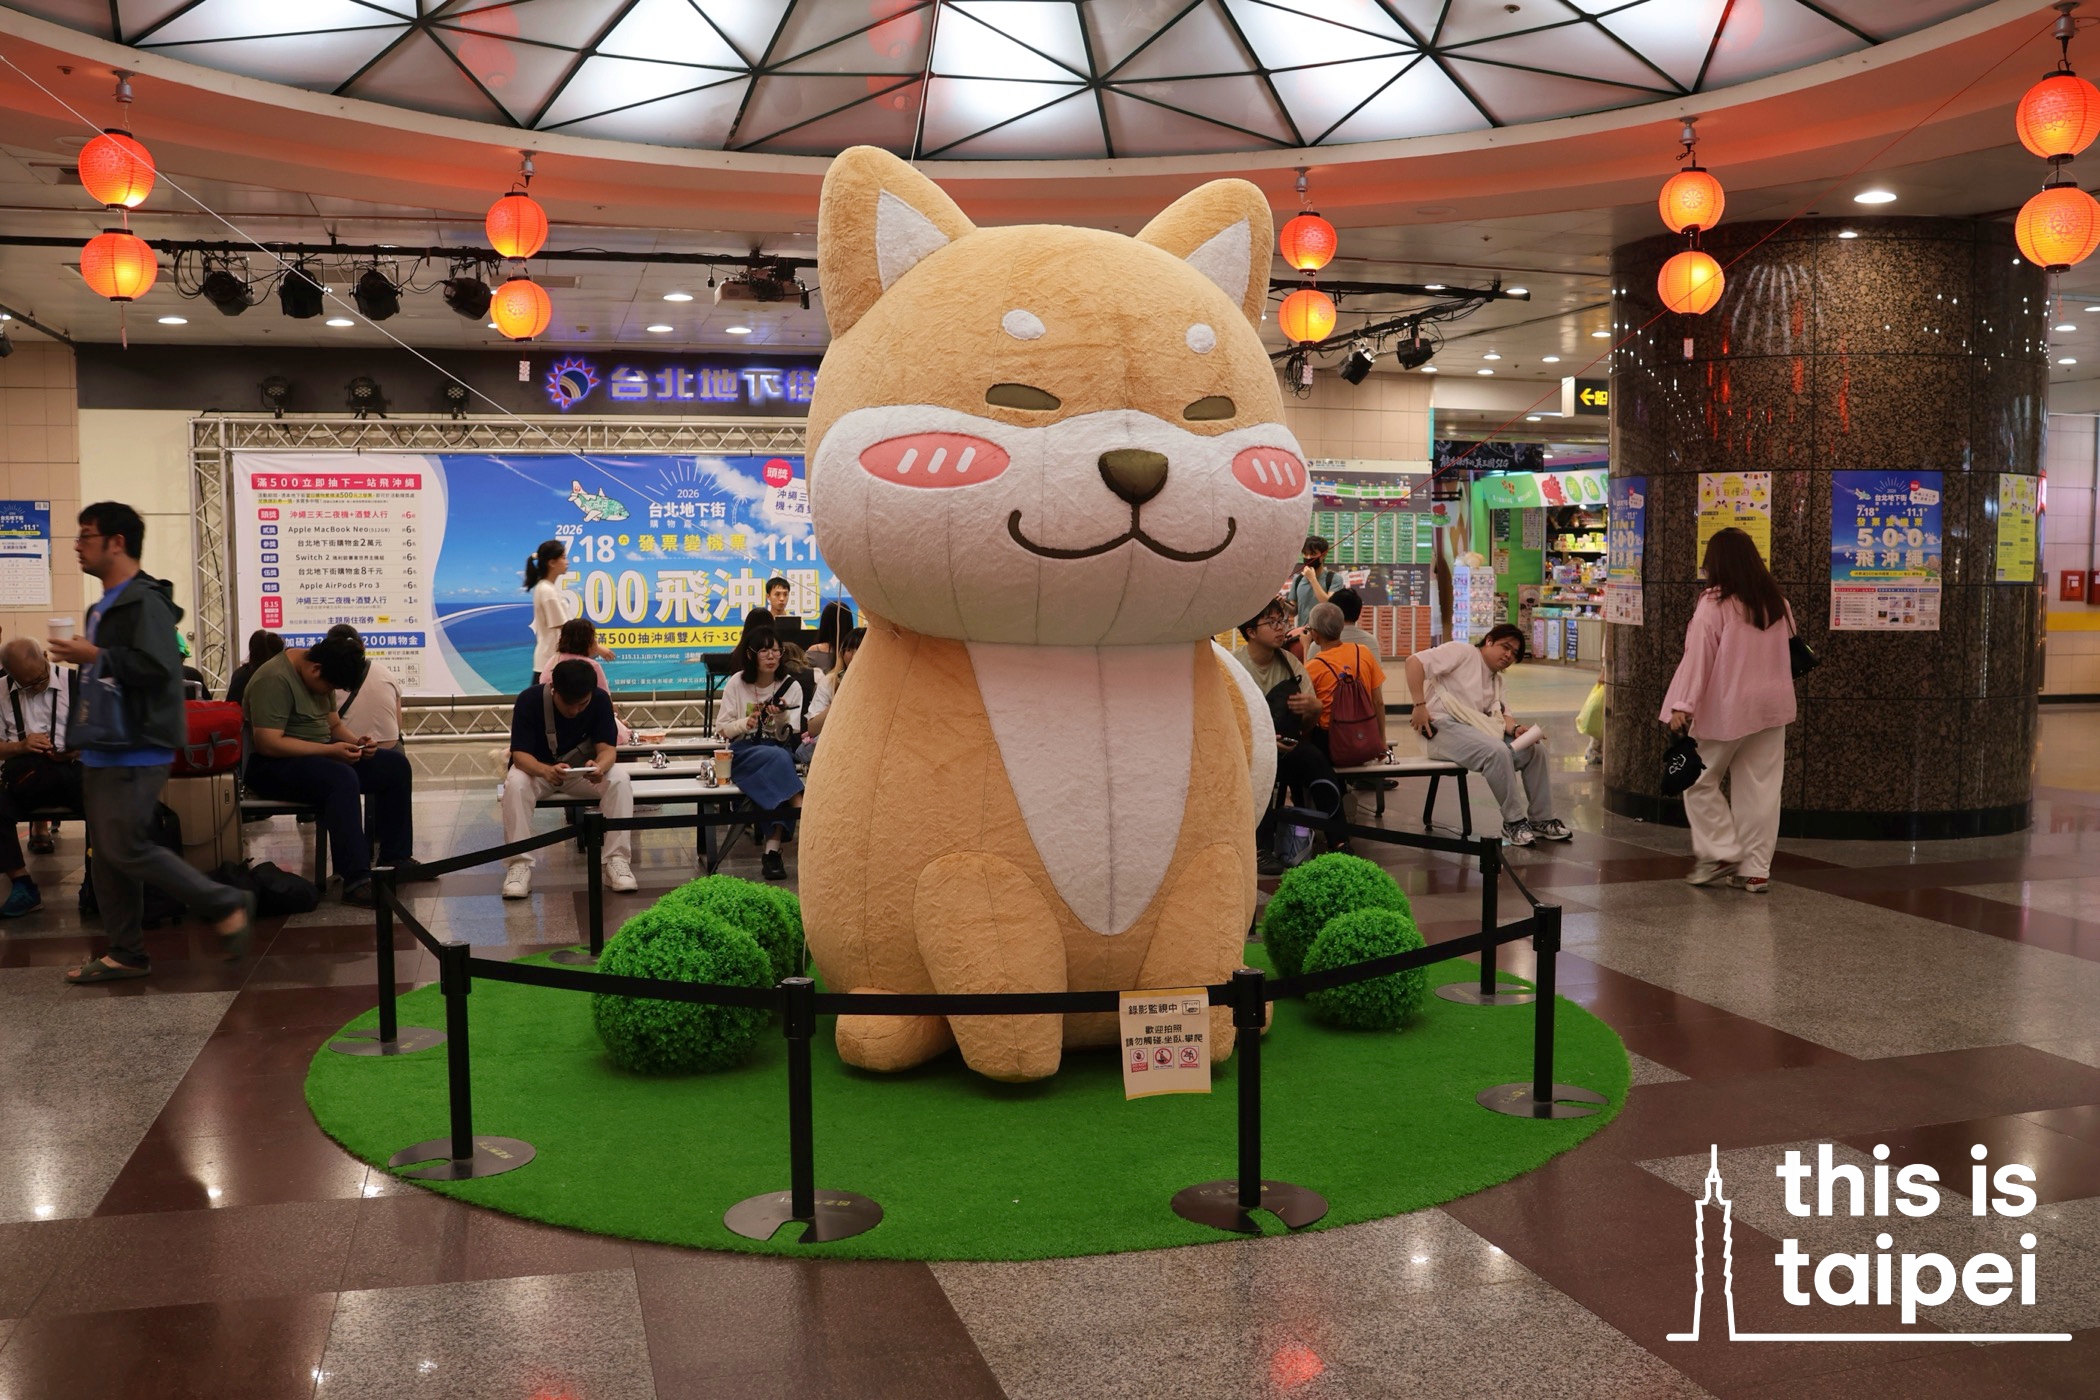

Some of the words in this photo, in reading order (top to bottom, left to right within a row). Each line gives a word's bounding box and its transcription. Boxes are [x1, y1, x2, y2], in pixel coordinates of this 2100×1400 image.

[611, 367, 815, 399] 台北地下街
[767, 466, 789, 480] 頭獎
[257, 477, 415, 488] 滿500立即抽下一站飛沖繩
[677, 489, 699, 499] 2026
[649, 501, 727, 519] 台北地下街
[1857, 508, 1876, 517] 7.18
[288, 526, 312, 535] Apple
[555, 525, 583, 535] 2026
[1857, 528, 1924, 548] 500
[555, 535, 616, 563] 7.18
[638, 533, 747, 553] 發票變機票
[295, 553, 323, 561] Switch
[299, 582, 323, 590] Apple
[556, 569, 651, 623] 500
[655, 567, 821, 624] 飛沖繩
[596, 631, 744, 645] 滿500抽沖繩雙人行、3C
[1128, 1002, 1178, 1016] 錄影監視中
[1145, 1024, 1182, 1035] 歡迎拍照
